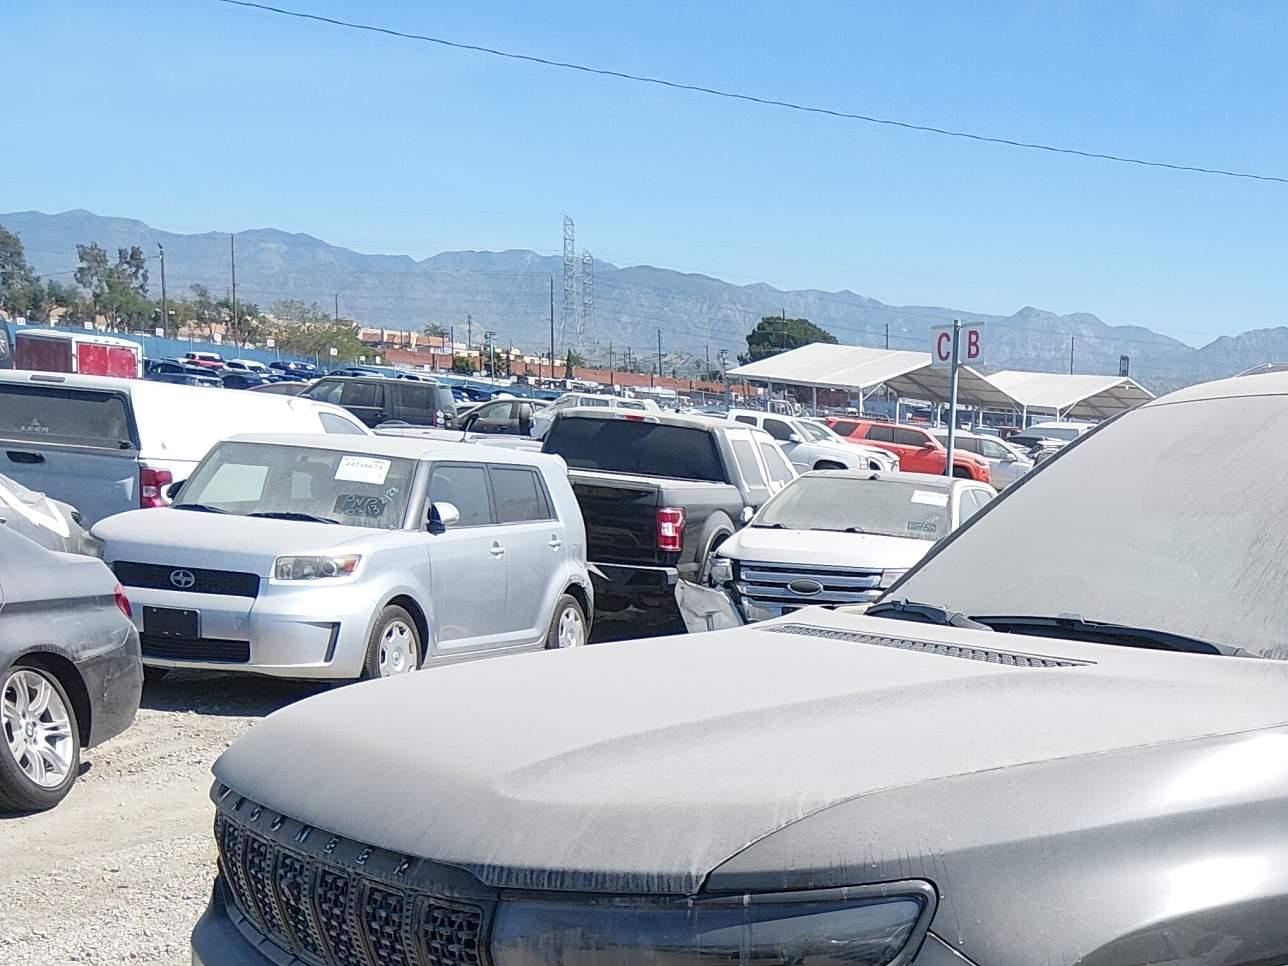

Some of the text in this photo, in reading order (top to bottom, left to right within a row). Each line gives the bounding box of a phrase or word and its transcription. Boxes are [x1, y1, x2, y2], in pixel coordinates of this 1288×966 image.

[937, 332, 951, 362] C
[967, 330, 980, 359] B
[343, 496, 378, 507] PNP
